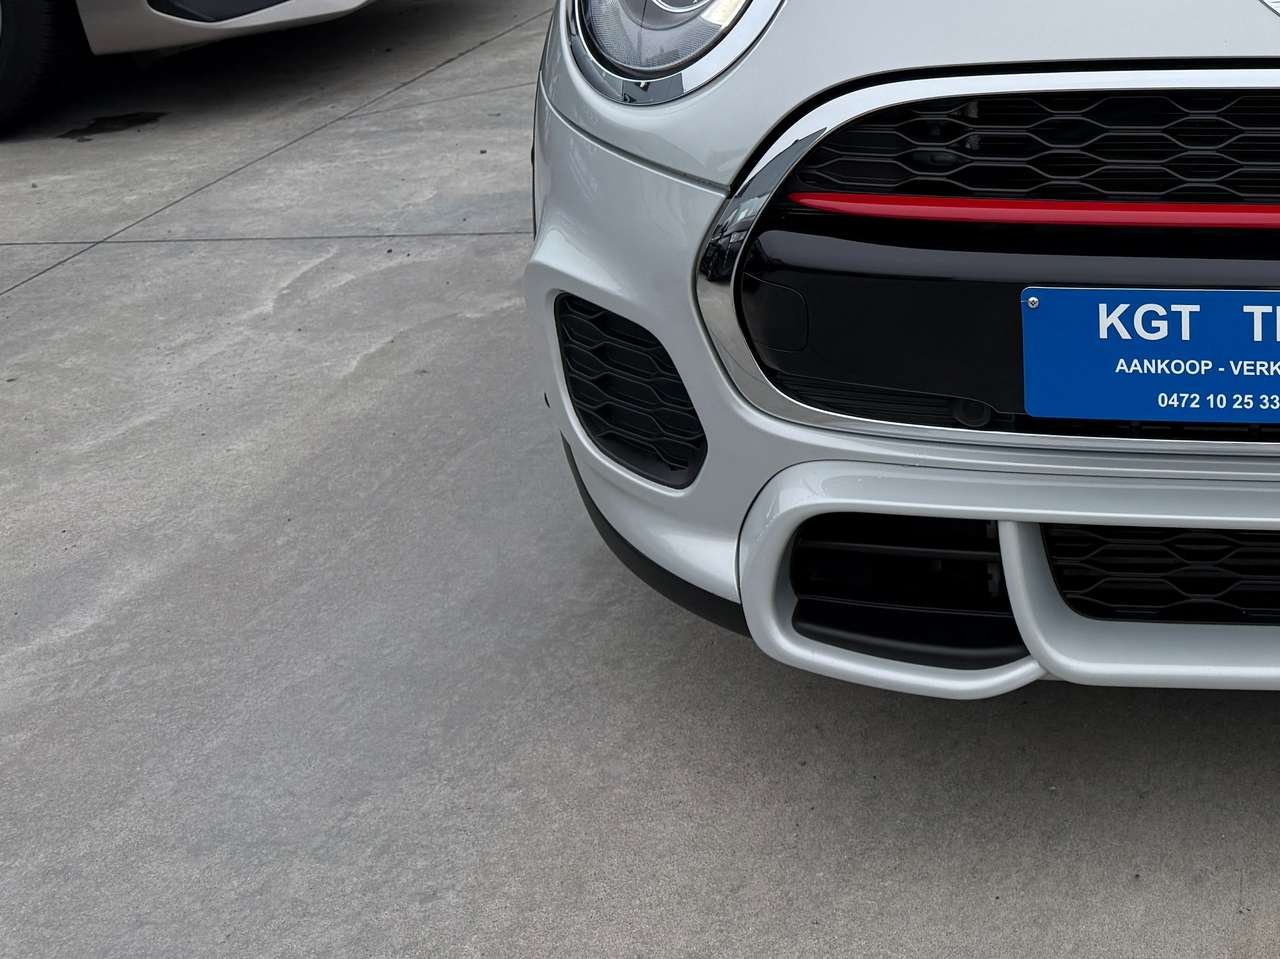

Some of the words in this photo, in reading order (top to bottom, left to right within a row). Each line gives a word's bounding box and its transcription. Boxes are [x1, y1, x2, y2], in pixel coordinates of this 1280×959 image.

[1098, 303, 1200, 341] KGT
[1115, 358, 1213, 375] AANKOOP
[1158, 392, 1200, 408] 0472
[1206, 393, 1227, 409] 10
[1232, 394, 1254, 409] 25
[1259, 394, 1280, 410] 33
